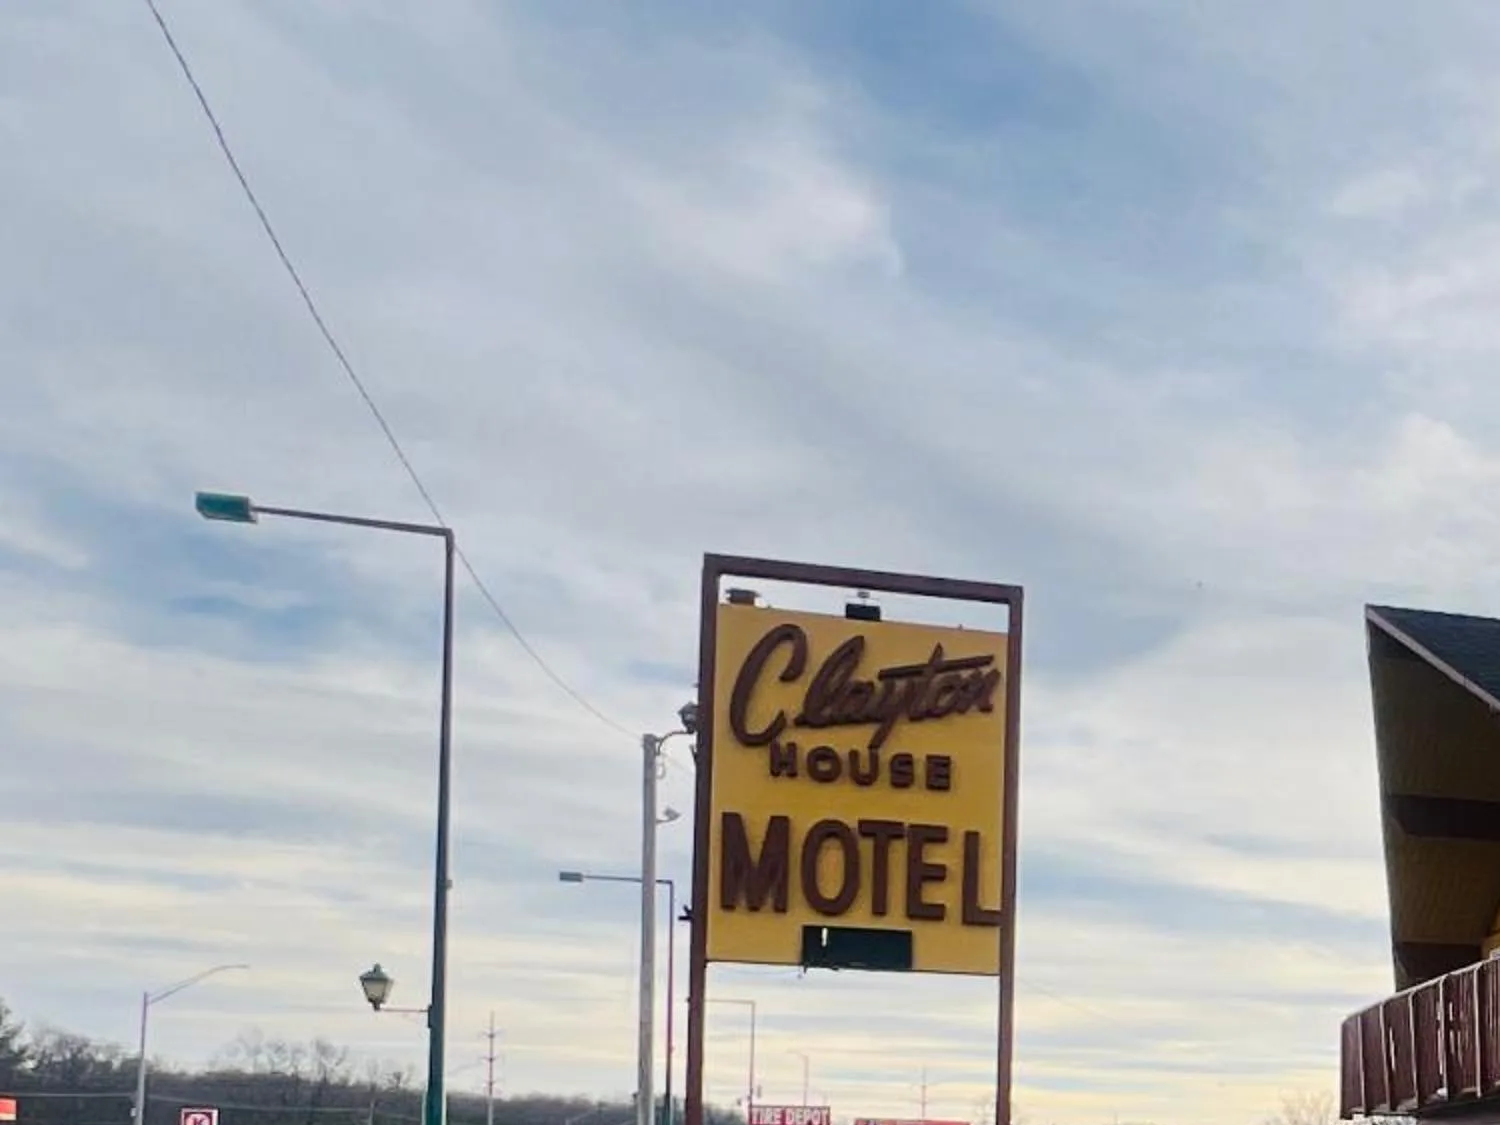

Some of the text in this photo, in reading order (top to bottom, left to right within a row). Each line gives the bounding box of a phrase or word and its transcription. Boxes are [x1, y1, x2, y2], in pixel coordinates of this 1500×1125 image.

[729, 623, 1001, 749] Clayton
[769, 740, 952, 791] HOUSE
[720, 811, 1002, 927] MOTEL
[752, 1107, 829, 1125] TIRE DEPOT
